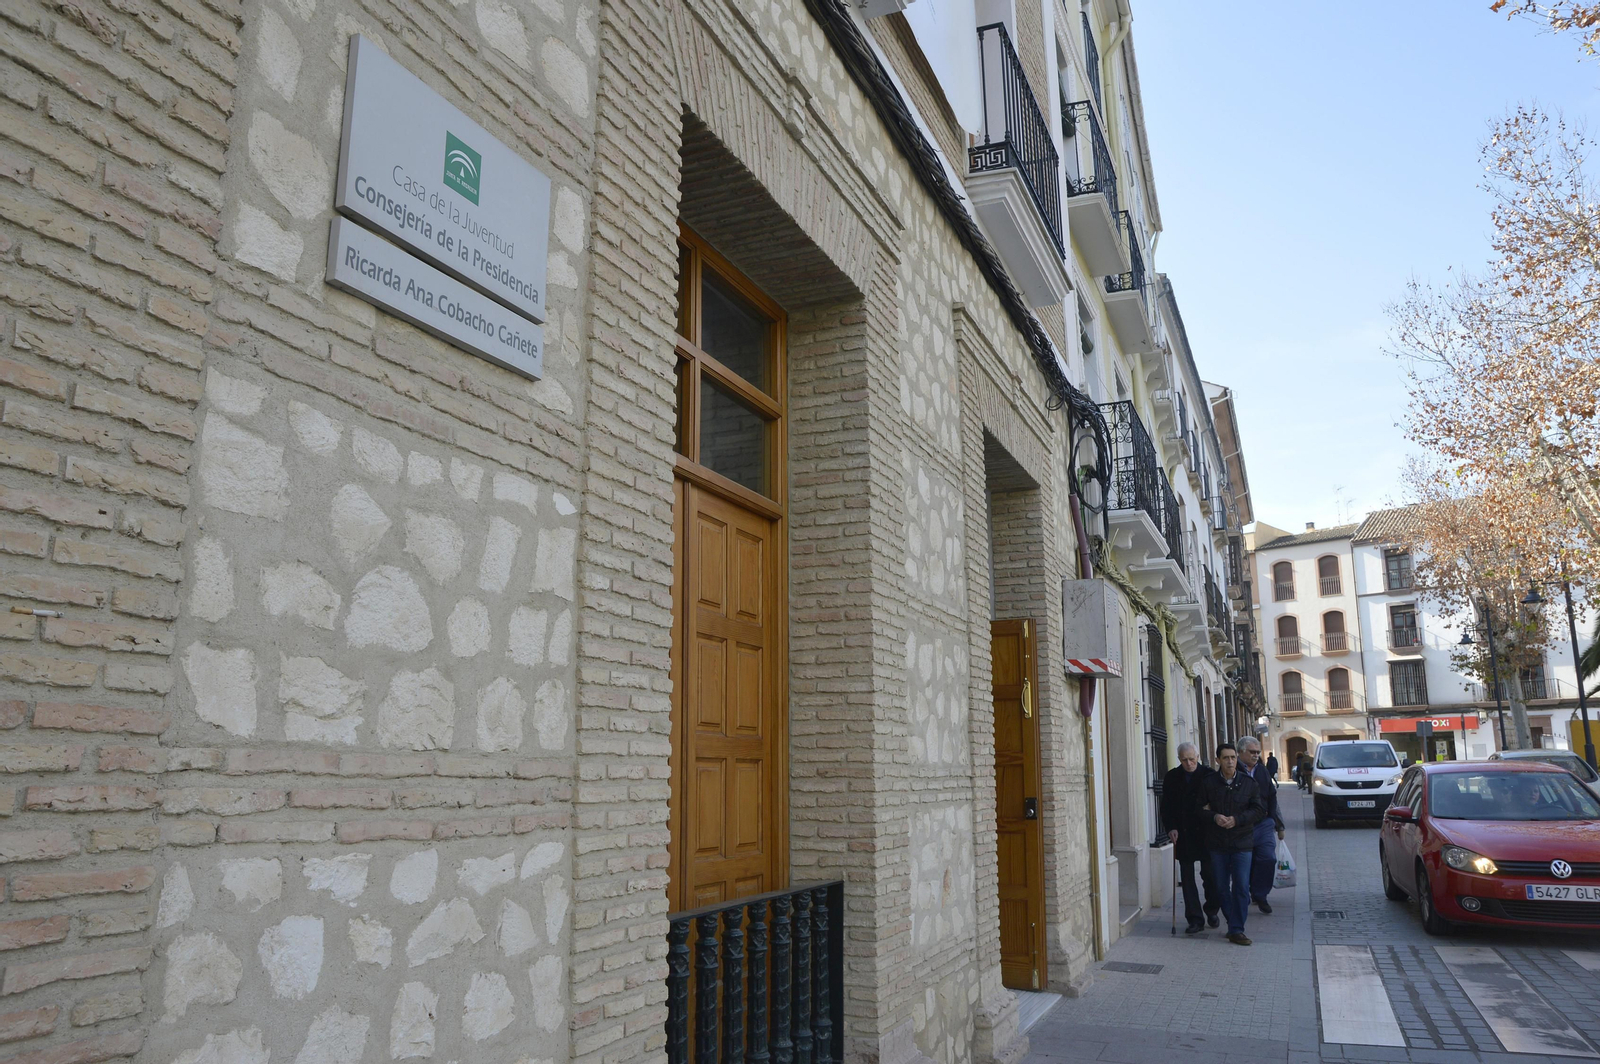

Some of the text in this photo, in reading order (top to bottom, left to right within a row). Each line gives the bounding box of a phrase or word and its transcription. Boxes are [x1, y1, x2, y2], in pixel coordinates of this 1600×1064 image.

[355, 176, 539, 304] Consejería de la Presidencia
[392, 165, 514, 260] Casa de la Juventud
[344, 245, 538, 359] Ricarda Ana Cobacho Cañete
[1535, 886, 1600, 900] 5427 GLR
